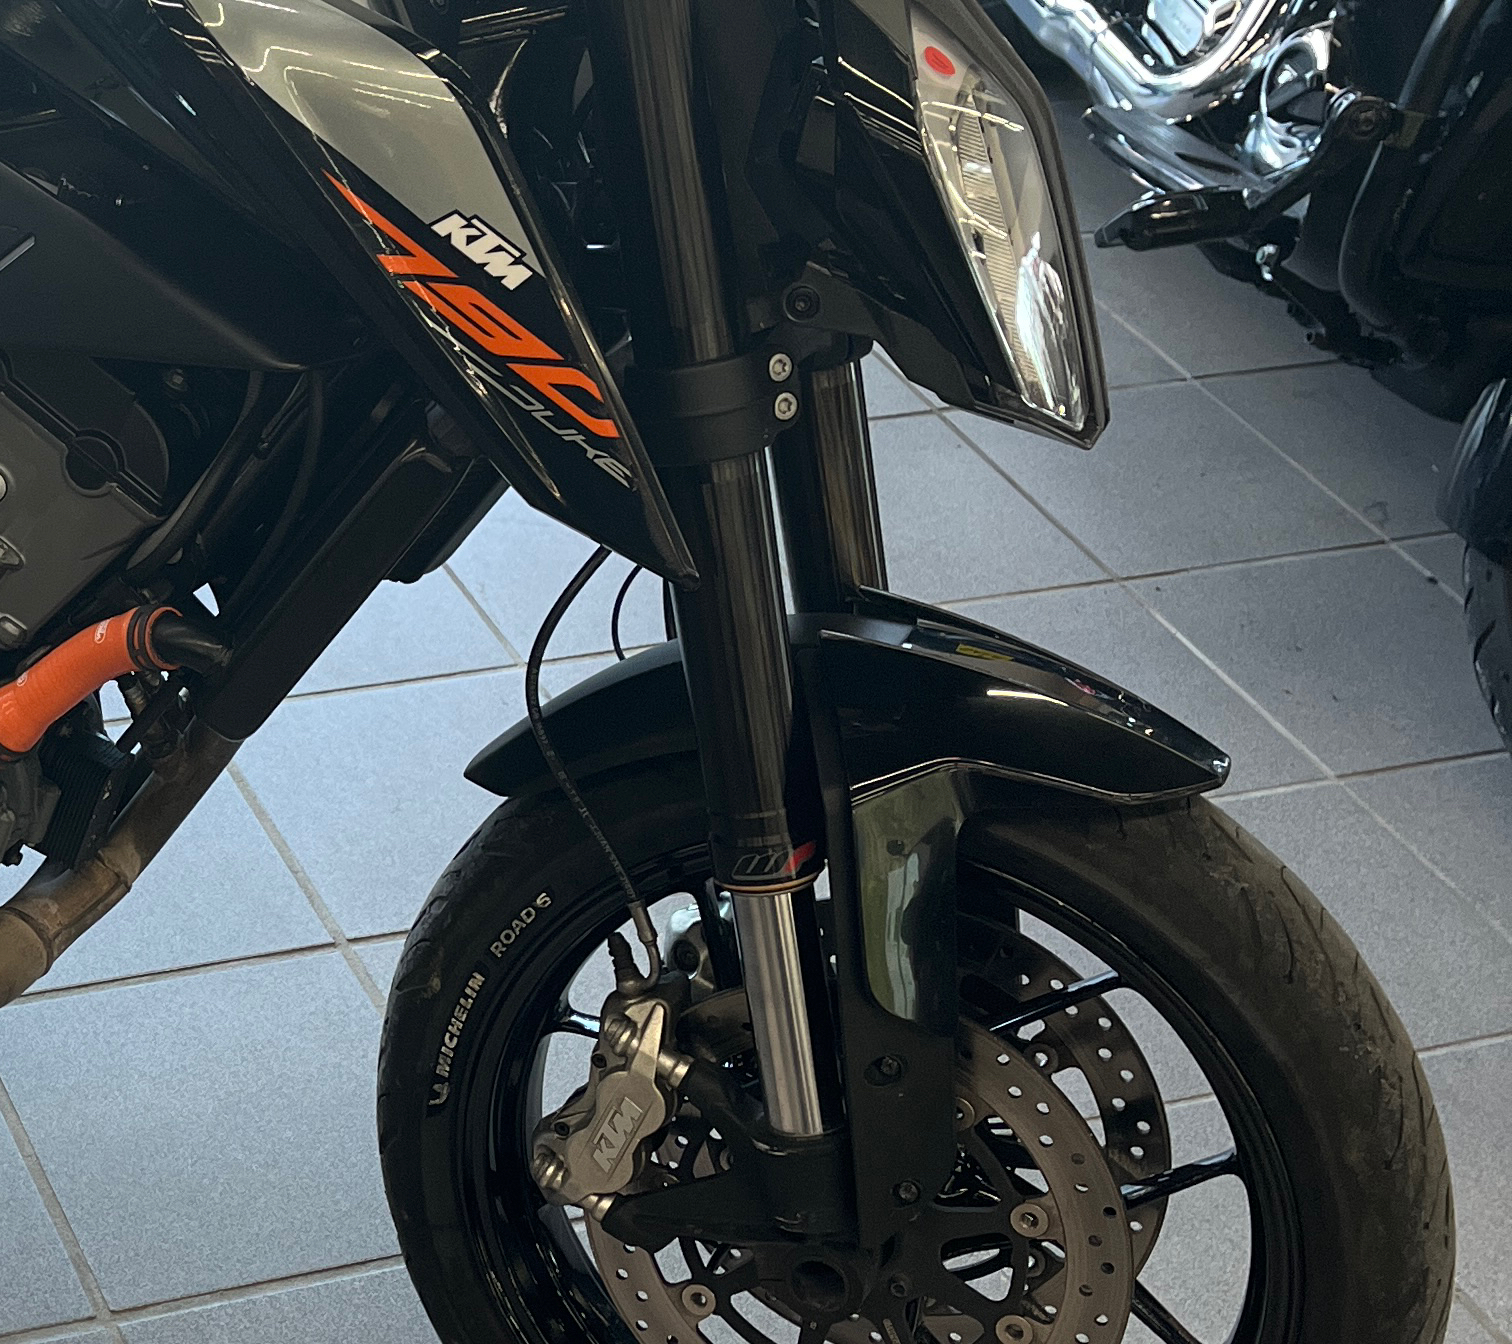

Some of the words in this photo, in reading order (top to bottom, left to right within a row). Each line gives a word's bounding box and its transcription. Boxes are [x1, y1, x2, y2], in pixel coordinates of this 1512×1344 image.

[323, 167, 621, 438] 790
[430, 213, 534, 291] KTM
[435, 971, 486, 1088] MICHELIN
[490, 906, 537, 958] ROAD
[592, 1096, 645, 1174] KTM
